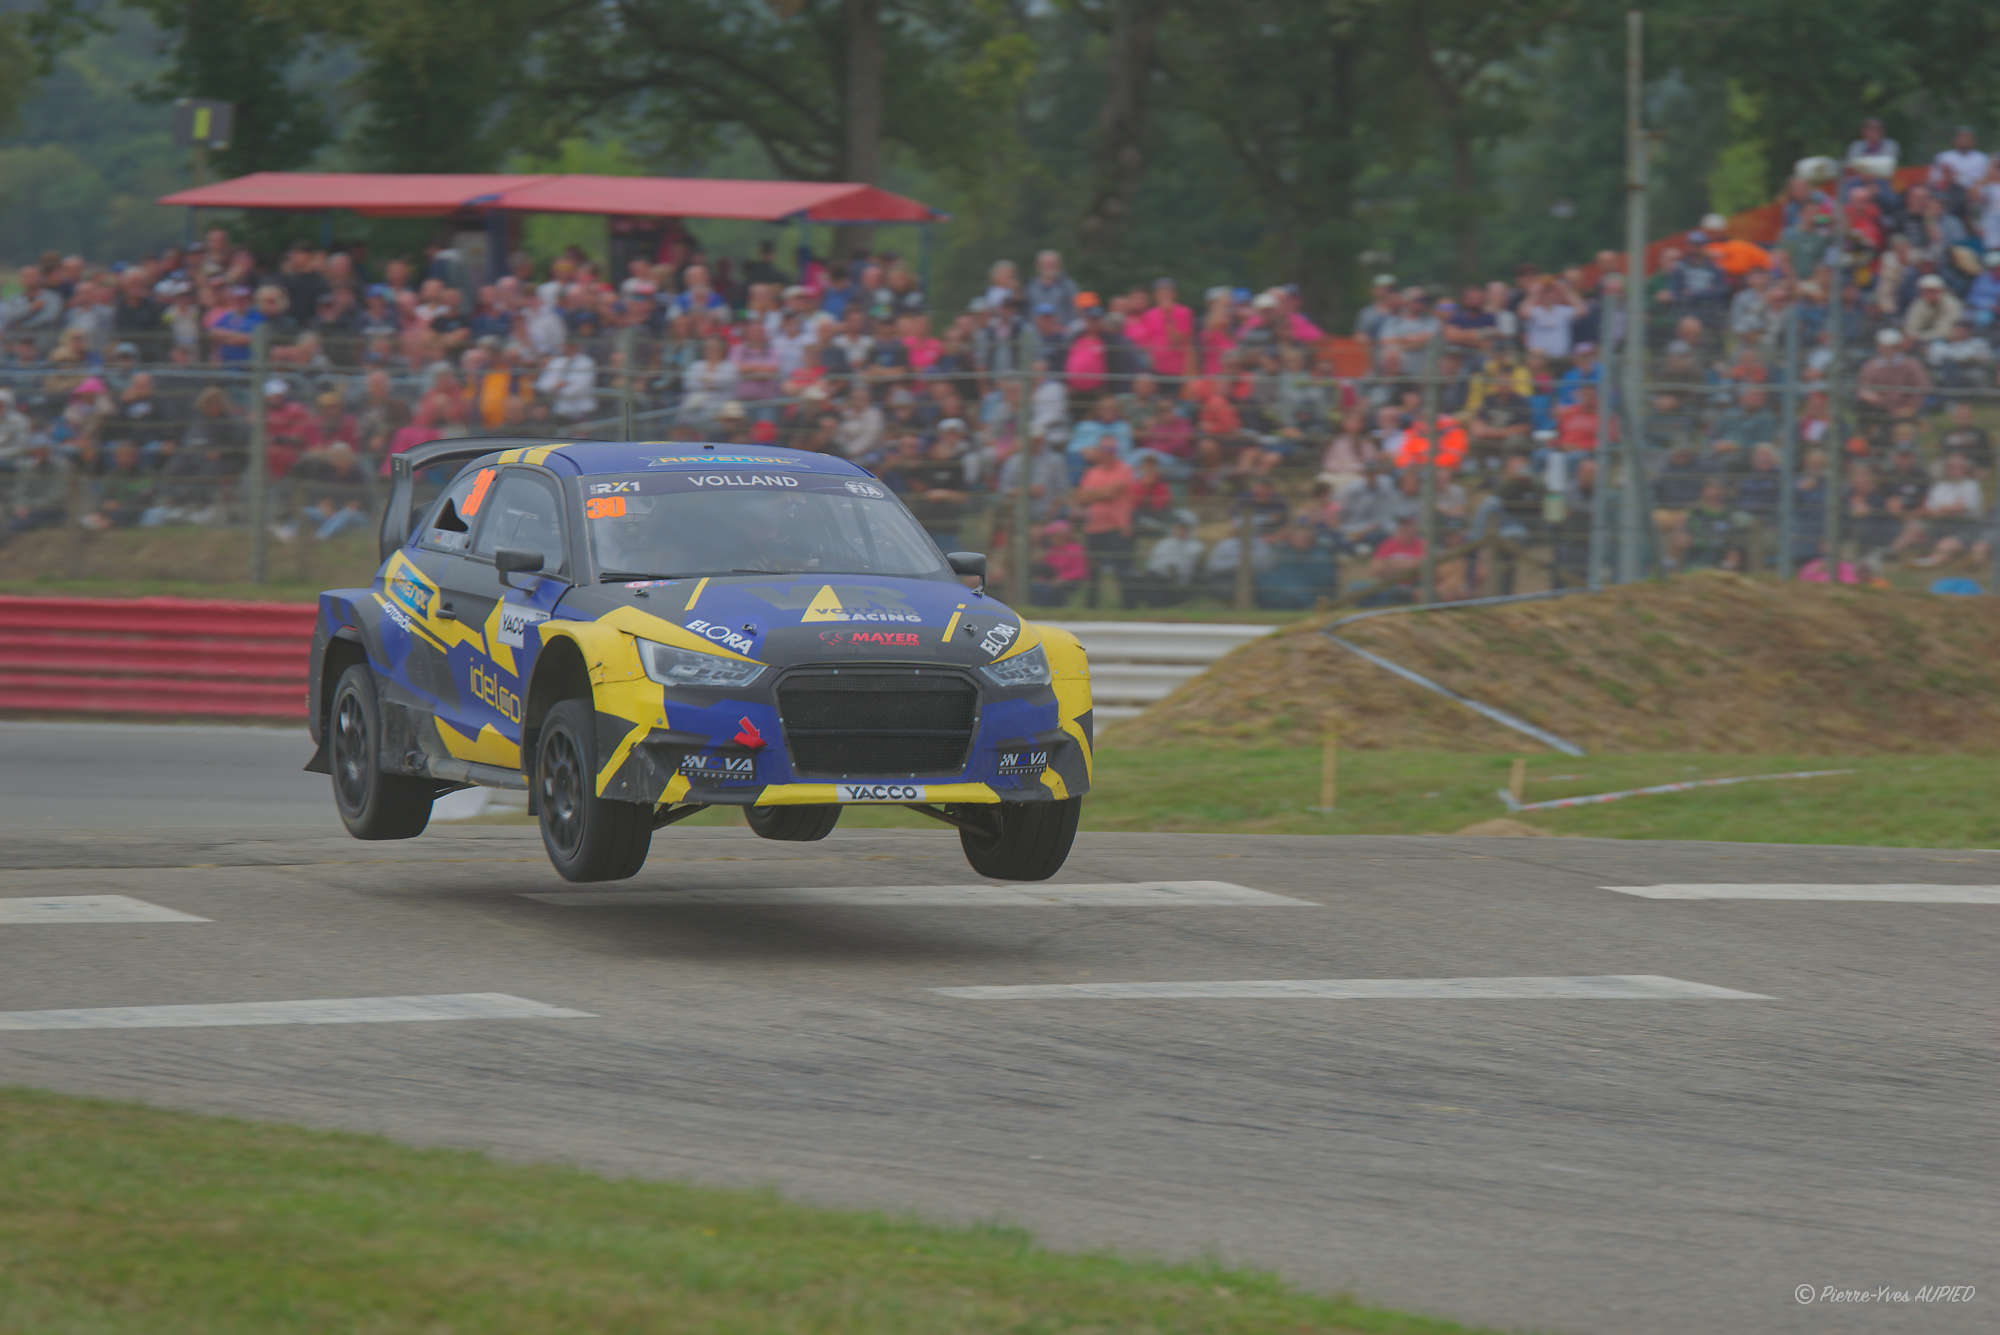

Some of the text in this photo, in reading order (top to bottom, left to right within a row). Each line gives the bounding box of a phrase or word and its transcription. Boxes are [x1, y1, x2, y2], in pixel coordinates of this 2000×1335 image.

[596, 481, 640, 495] RX1
[688, 475, 799, 487] VOLLAND
[847, 482, 883, 498] FIA
[586, 496, 625, 519] 30
[837, 613, 922, 623] RACING
[685, 619, 753, 655] ELORA
[852, 632, 919, 642] MAYER
[980, 623, 1018, 657] ELORA
[470, 656, 521, 724] idelco
[684, 755, 753, 771] NOVA
[1002, 751, 1047, 766] NOVA
[845, 785, 917, 800] YACCO
